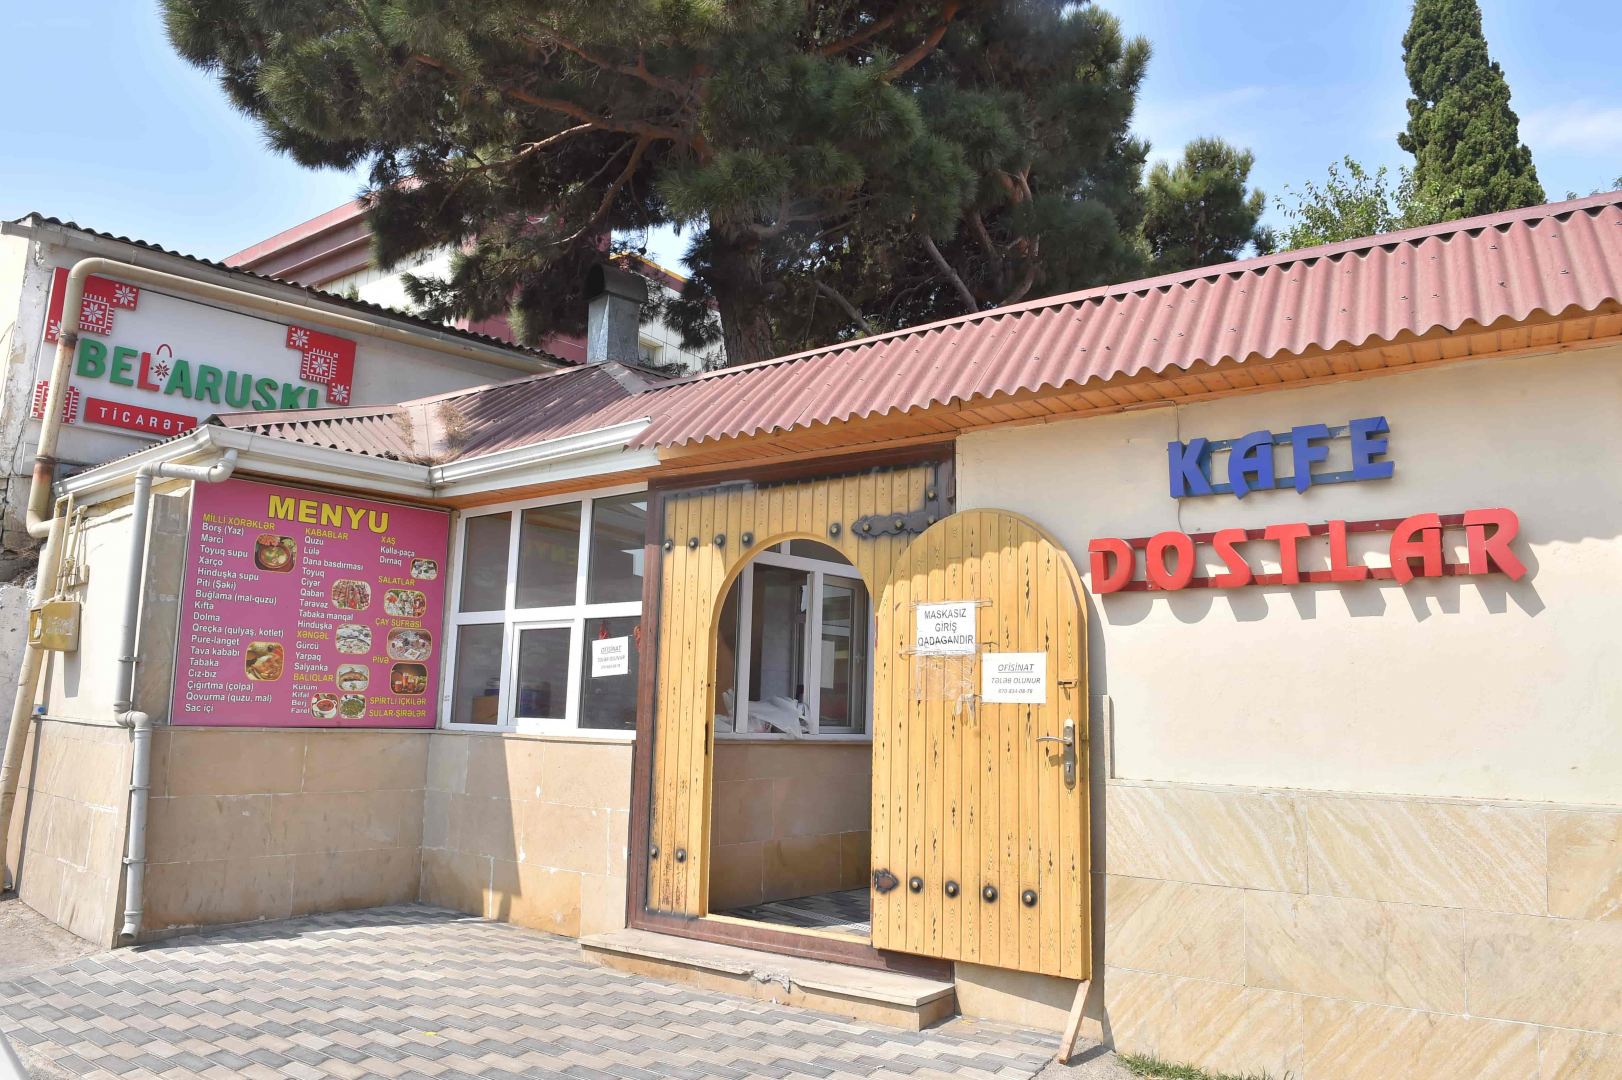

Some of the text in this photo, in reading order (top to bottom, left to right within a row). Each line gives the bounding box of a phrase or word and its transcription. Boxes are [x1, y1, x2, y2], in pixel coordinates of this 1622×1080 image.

[76, 337, 319, 411] BELARUSKI
[99, 405, 185, 432] TİCARƏT
[1167, 415, 1396, 500] KAFE
[267, 494, 389, 534] MENYU
[224, 525, 244, 536] (Yaz)
[305, 527, 349, 540] KABABLAR
[304, 535, 324, 546] Quzu
[199, 544, 248, 558] Toyuq supu
[1088, 507, 1528, 594] DOSTLAR
[302, 556, 322, 566] Dana
[239, 573, 259, 581] supu
[302, 566, 325, 578] Toyuq
[378, 575, 416, 586] SALATLAR
[234, 592, 277, 605] (mal-quzu)
[300, 588, 324, 598] Qaban
[298, 609, 324, 619] Tabaka
[924, 608, 967, 619] MASKASIZ
[375, 617, 389, 627] ÇAY
[934, 620, 957, 633] GİRİŞ
[259, 628, 284, 639] kotlet)
[190, 645, 210, 655] Tava
[295, 651, 322, 661] Yarpaq
[189, 657, 219, 667] Tabaka
[186, 691, 225, 701] Qovurma
[185, 703, 201, 712] Sac
